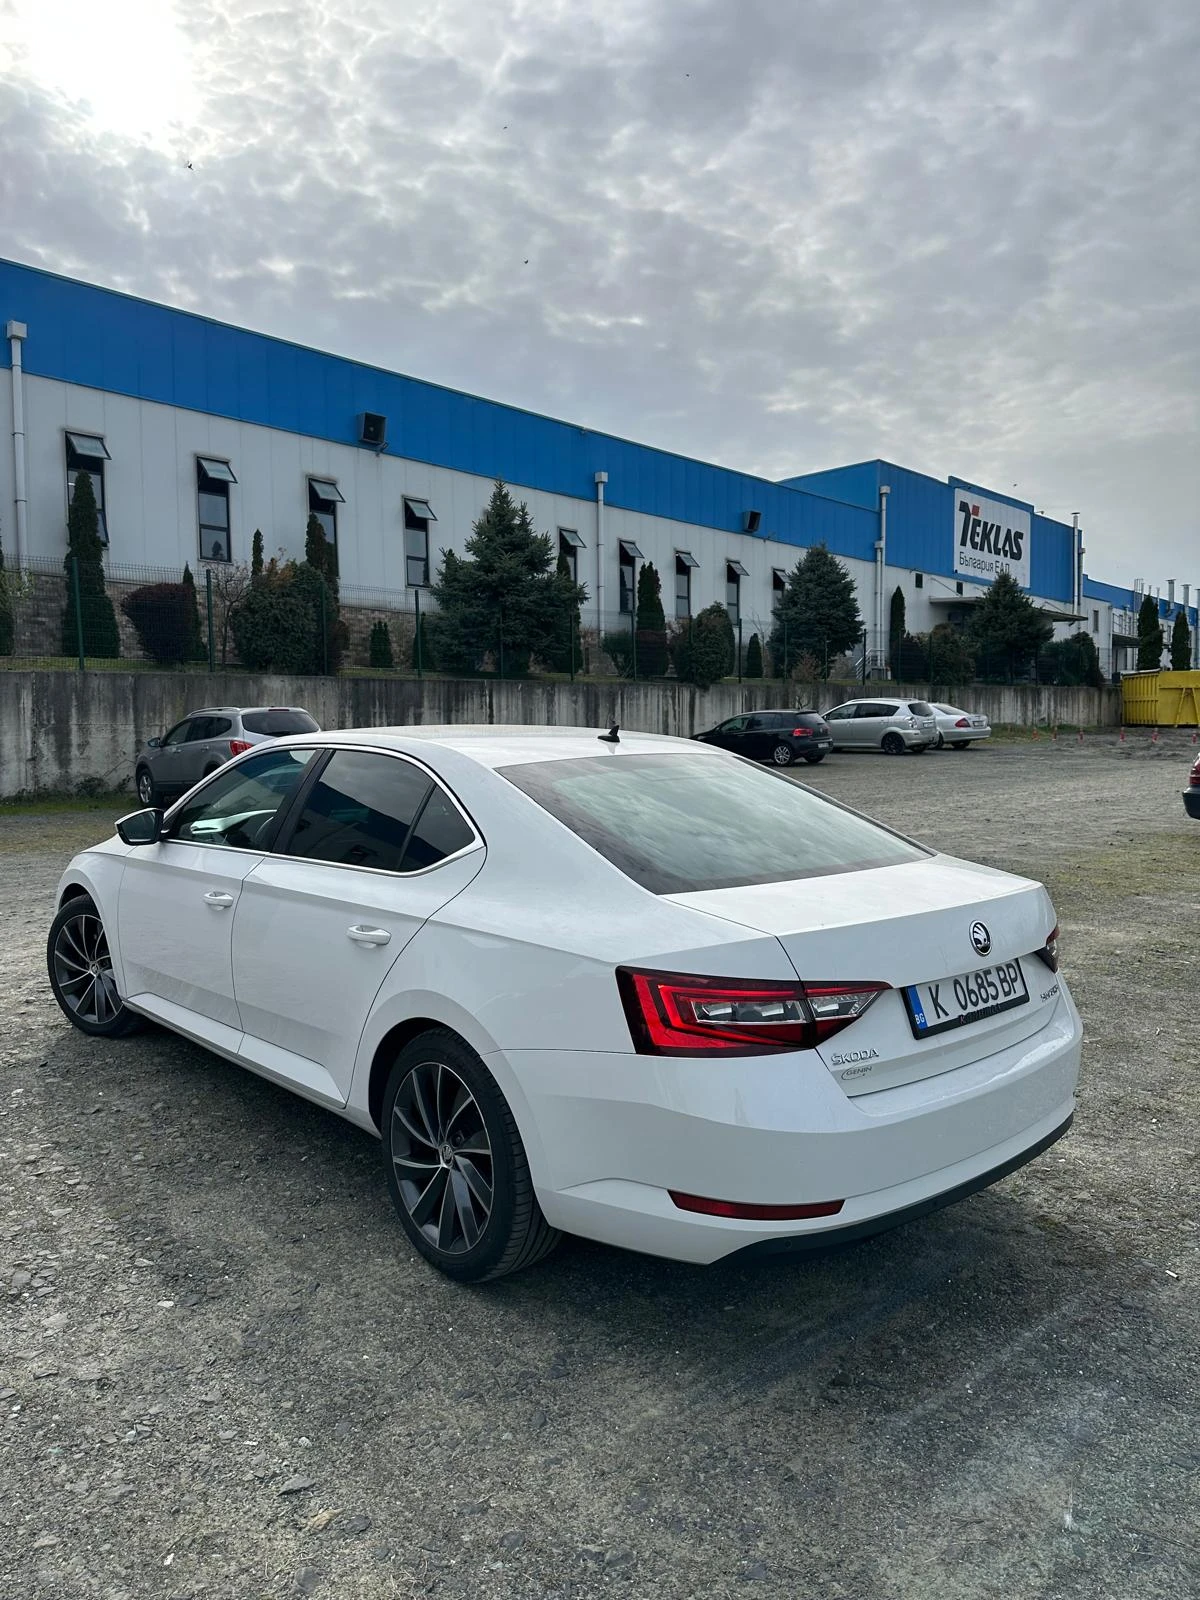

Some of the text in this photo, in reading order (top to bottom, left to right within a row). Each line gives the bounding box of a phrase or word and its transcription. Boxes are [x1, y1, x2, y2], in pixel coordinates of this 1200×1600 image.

[959, 501, 1024, 561] TEKLAS
[959, 551, 994, 573] България
[928, 983, 949, 1019] K
[915, 1013, 925, 1024] BG
